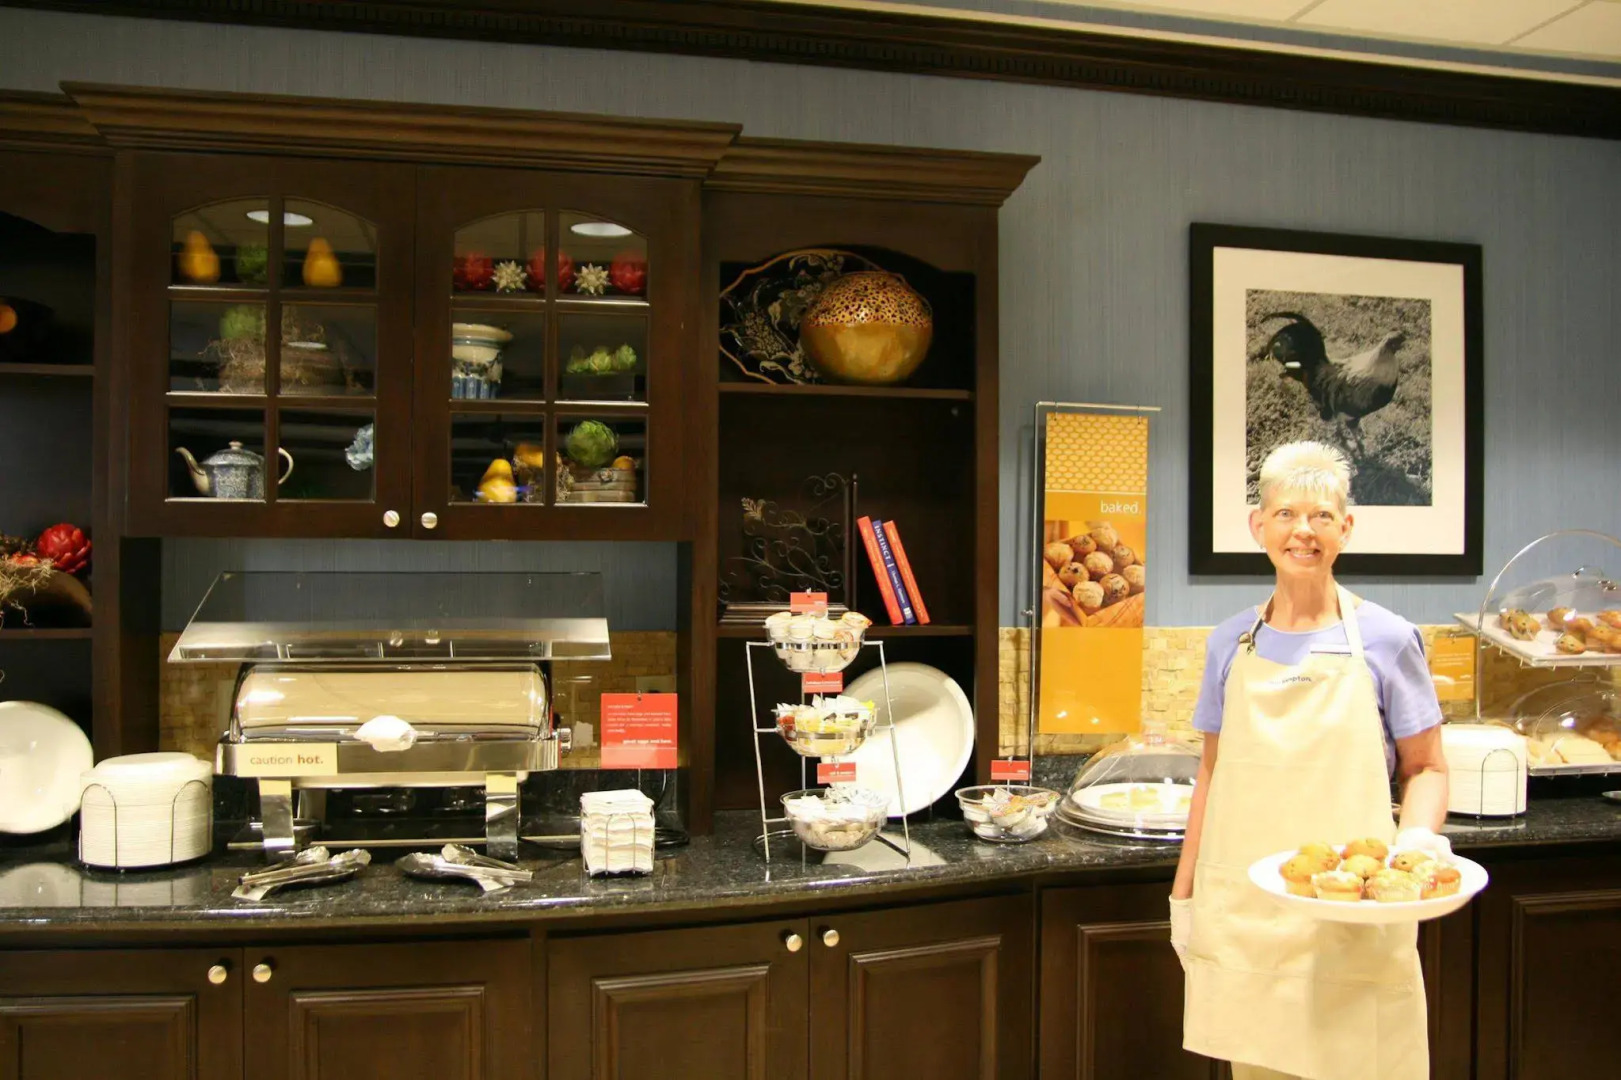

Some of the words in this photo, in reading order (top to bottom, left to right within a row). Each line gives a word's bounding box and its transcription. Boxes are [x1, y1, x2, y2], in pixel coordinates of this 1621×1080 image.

[874, 525, 891, 560] INSTINCT
[249, 755, 293, 765] caution
[297, 754, 324, 765] hot.
